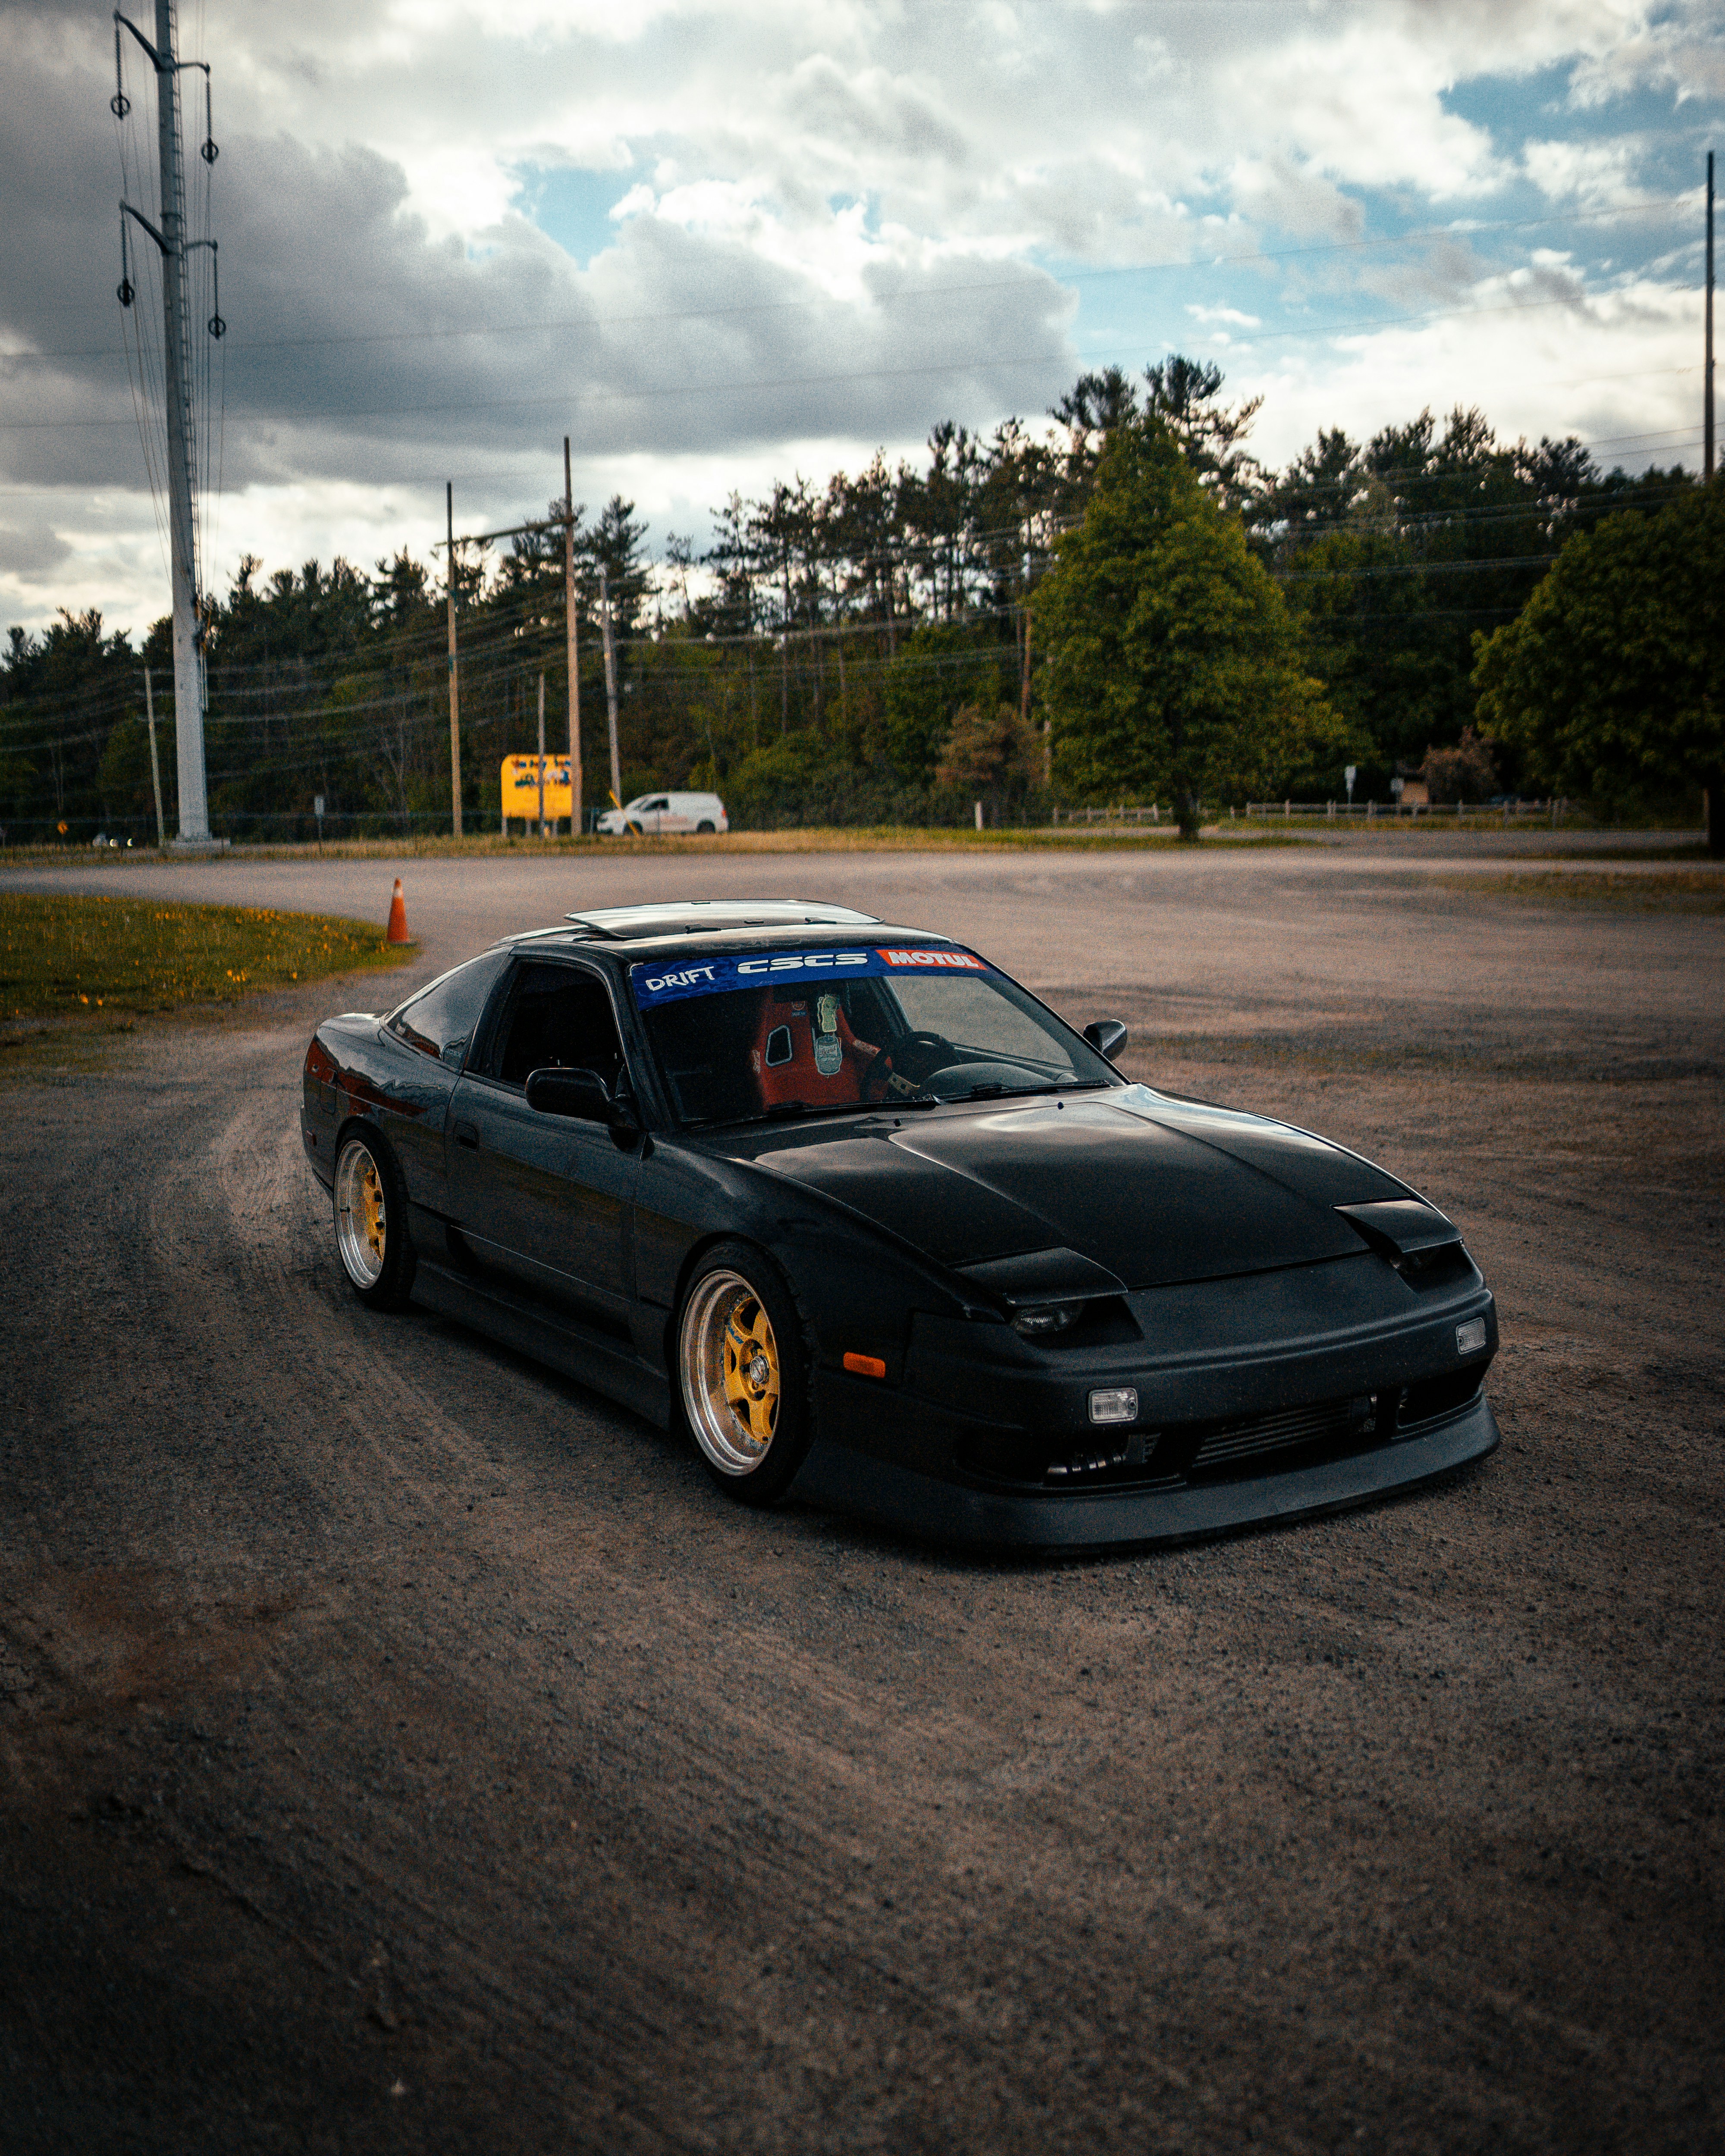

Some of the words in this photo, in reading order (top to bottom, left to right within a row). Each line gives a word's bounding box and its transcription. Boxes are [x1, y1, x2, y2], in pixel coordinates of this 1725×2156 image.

[646, 966, 715, 991] DRIFT
[738, 953, 868, 974] CSCS
[888, 952, 979, 967] MOTUL
